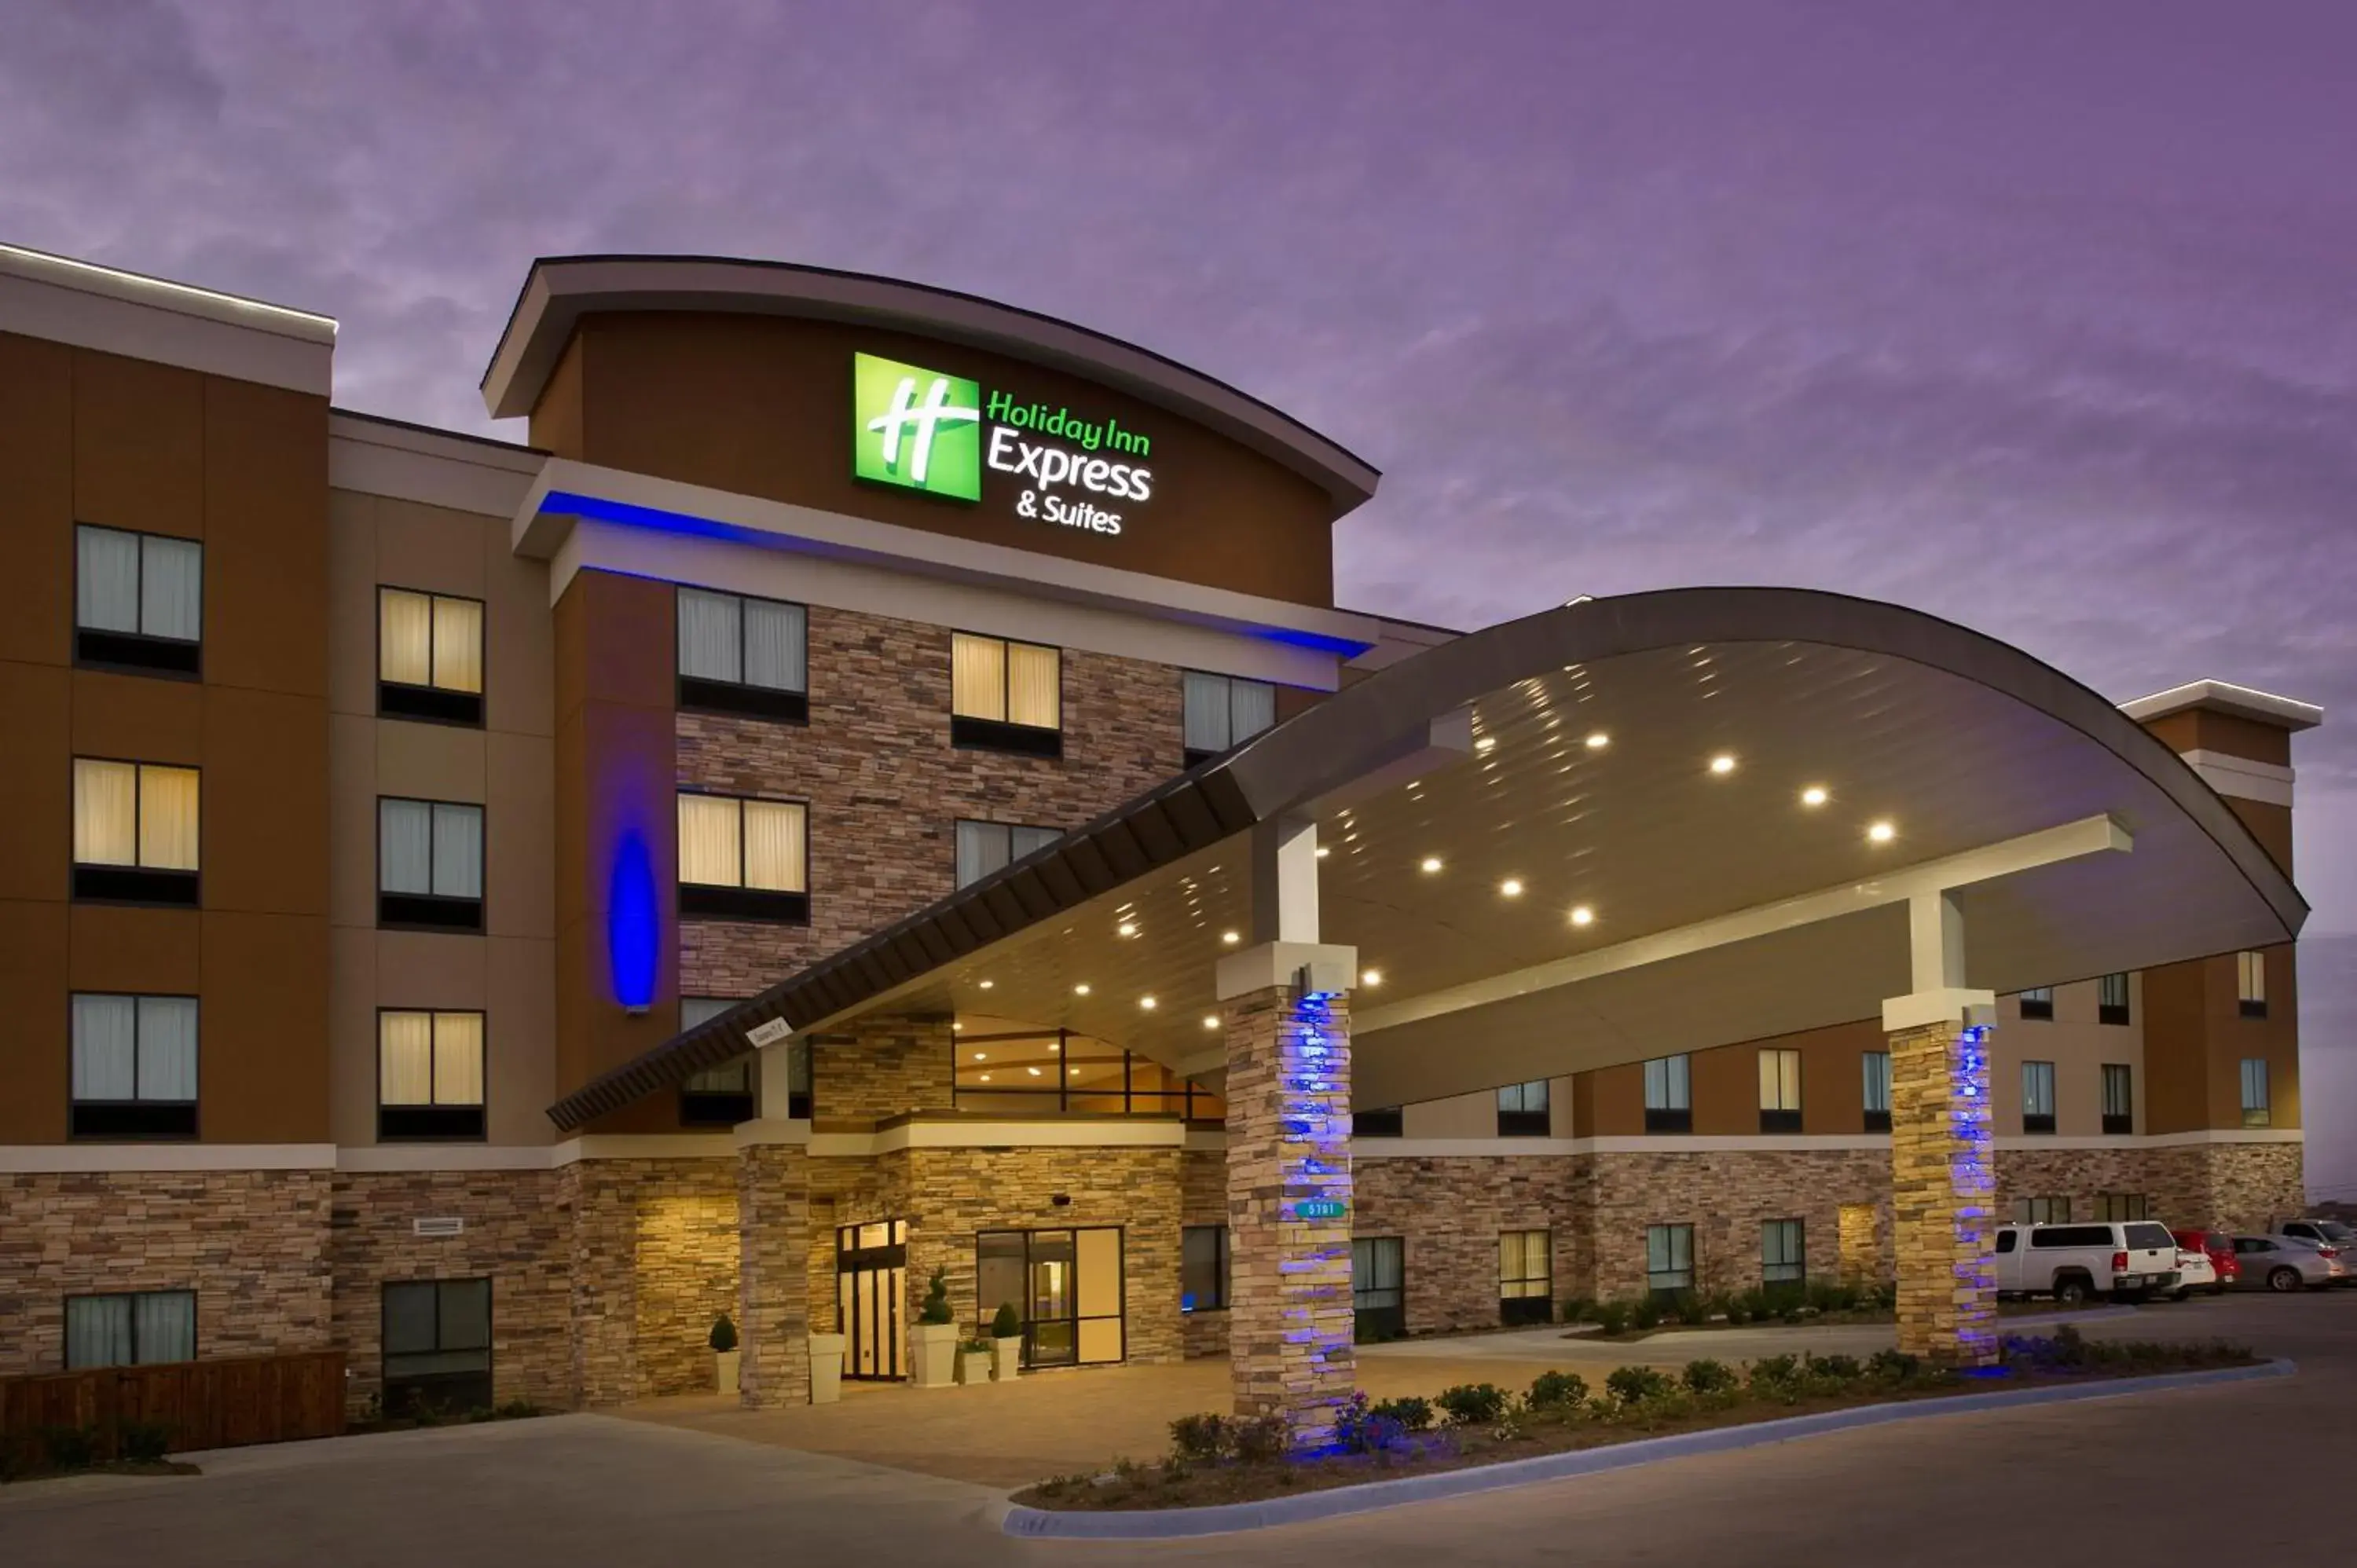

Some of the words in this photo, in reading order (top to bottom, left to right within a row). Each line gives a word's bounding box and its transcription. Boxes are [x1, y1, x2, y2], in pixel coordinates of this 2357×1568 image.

[987, 390, 1102, 450] Holiday
[1105, 419, 1150, 456] Inn
[988, 427, 1152, 501] Express
[1016, 490, 1037, 518] &
[1042, 496, 1123, 535] Suites
